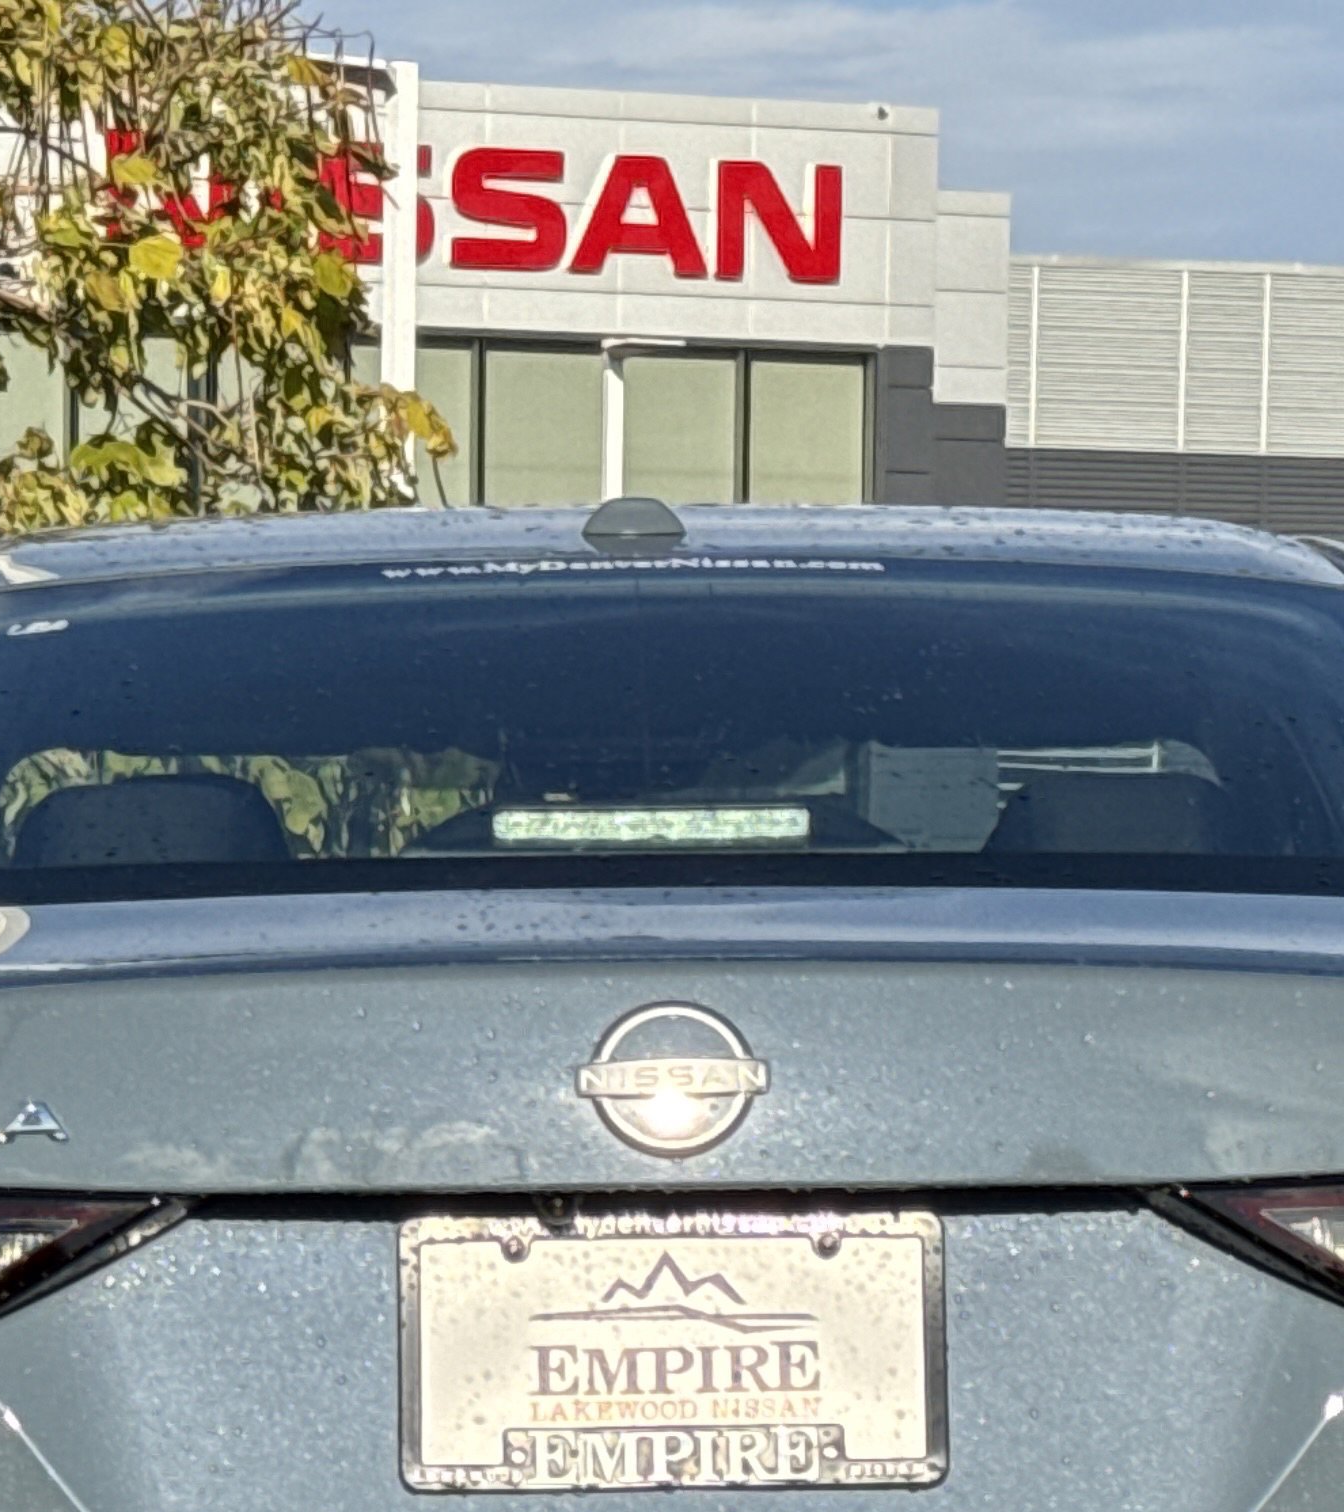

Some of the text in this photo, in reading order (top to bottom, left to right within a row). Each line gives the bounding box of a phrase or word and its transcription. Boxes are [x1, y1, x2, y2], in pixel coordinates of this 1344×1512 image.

[106, 130, 842, 284] SSAN
[579, 1064, 769, 1093] NISSAN
[527, 1340, 821, 1396] EMPIRE
[529, 1397, 824, 1423] LAKEWOOD NISSAN
[526, 1425, 820, 1485] EMPIRE
